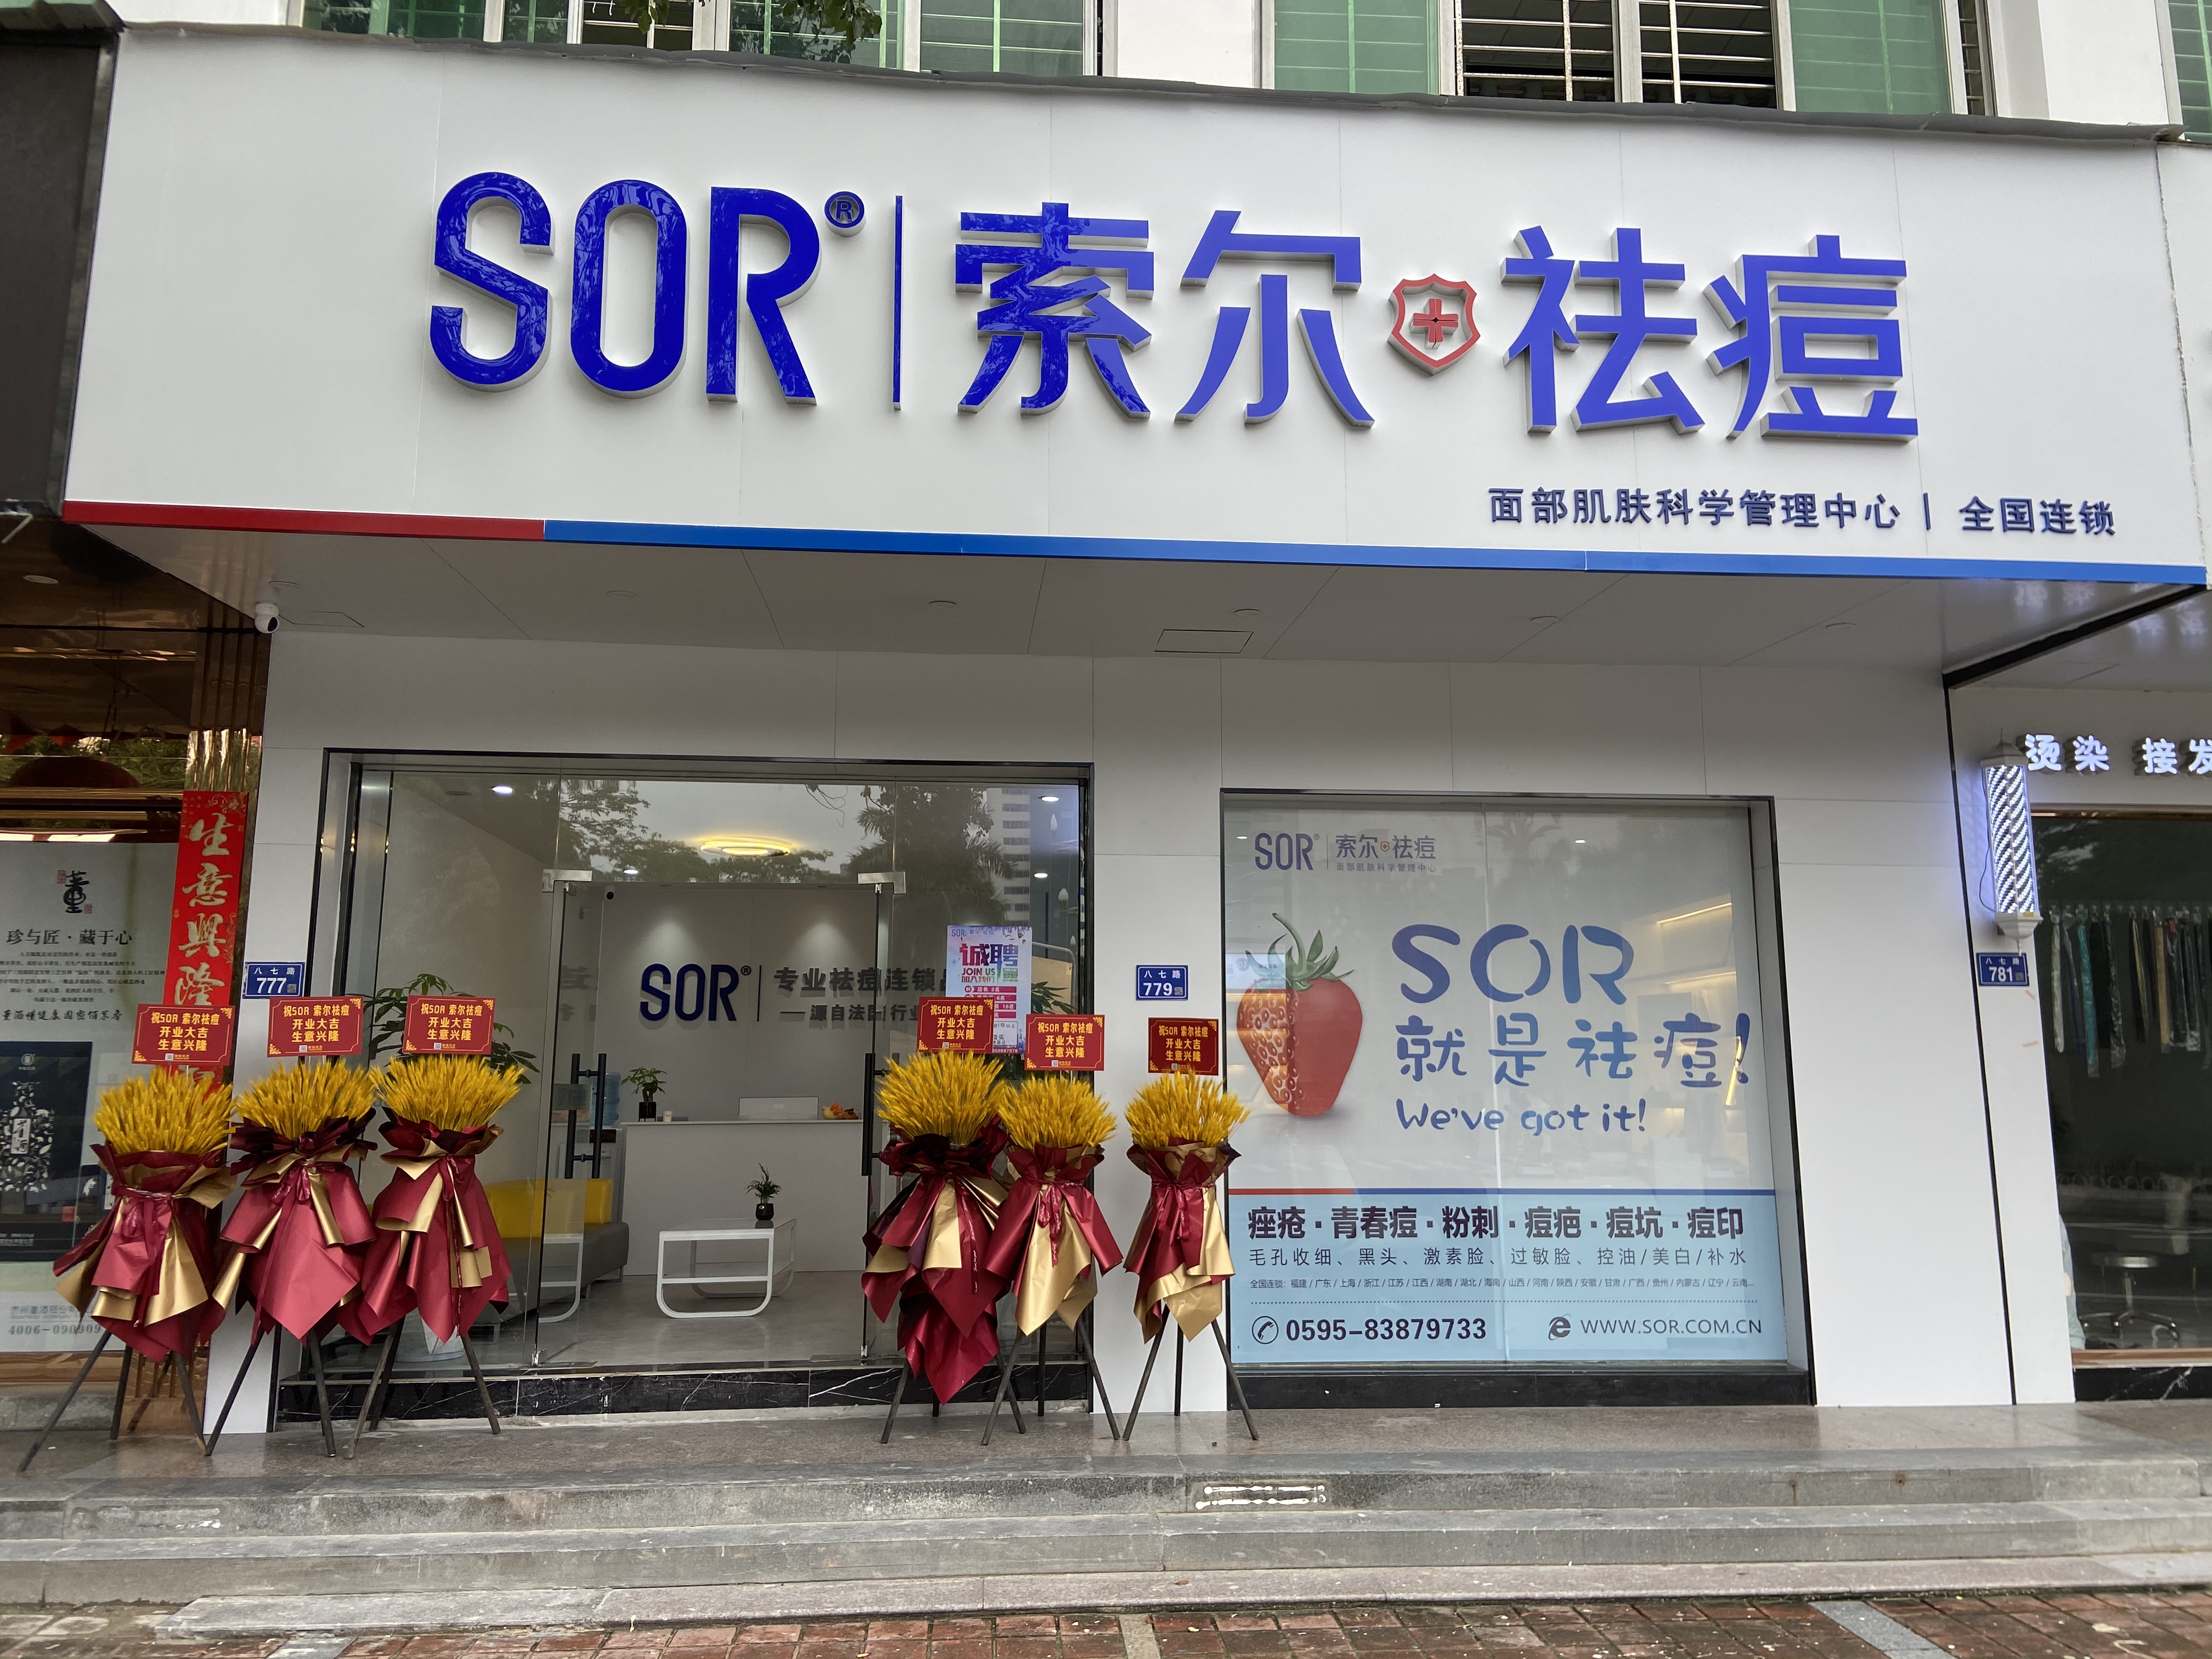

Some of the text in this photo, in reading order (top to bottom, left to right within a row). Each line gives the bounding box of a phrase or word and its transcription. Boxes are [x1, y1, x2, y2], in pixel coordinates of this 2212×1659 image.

[1488, 487, 2116, 535] 面部肌肤科学管理中心 全国连锁
[2025, 734, 2110, 772] 烫染
[1336, 862, 1436, 872] 面部肌肤科学管理中心
[960, 937, 1018, 970] 诚聘
[1392, 924, 1634, 1005] SOR
[1144, 970, 1181, 978] 八七路
[1989, 966, 2013, 982] 781
[257, 978, 286, 993] 777
[1143, 983, 1172, 996] 779
[313, 1004, 349, 1016] 索尔祛痘
[448, 1003, 483, 1016] 索尔祛痘
[954, 1005, 984, 1016] 索尔祛痘
[182, 1013, 219, 1025] 索尔祛痘
[292, 1018, 340, 1030] 开业大吉
[428, 1017, 473, 1028] 开业大吉
[937, 1017, 975, 1029] 开业大吉
[159, 1026, 208, 1038] 开业大吉
[1062, 1022, 1093, 1034] 索尔祛痘
[291, 1030, 339, 1042] 生意兴隆
[427, 1029, 471, 1041] 生意兴隆
[936, 1029, 975, 1040] 生意兴隆
[1045, 1035, 1085, 1046] 开业大吉
[157, 1039, 207, 1051] 生意兴隆
[1165, 1038, 1201, 1050] 开业大吉
[1045, 1047, 1085, 1058] 生意兴隆
[1165, 1050, 1201, 1062] 生意兴隆
[1395, 1098, 1646, 1136] We've got it!
[1286, 1318, 1762, 1341] 0595-83879733 WWW.SOR.COM.CN
